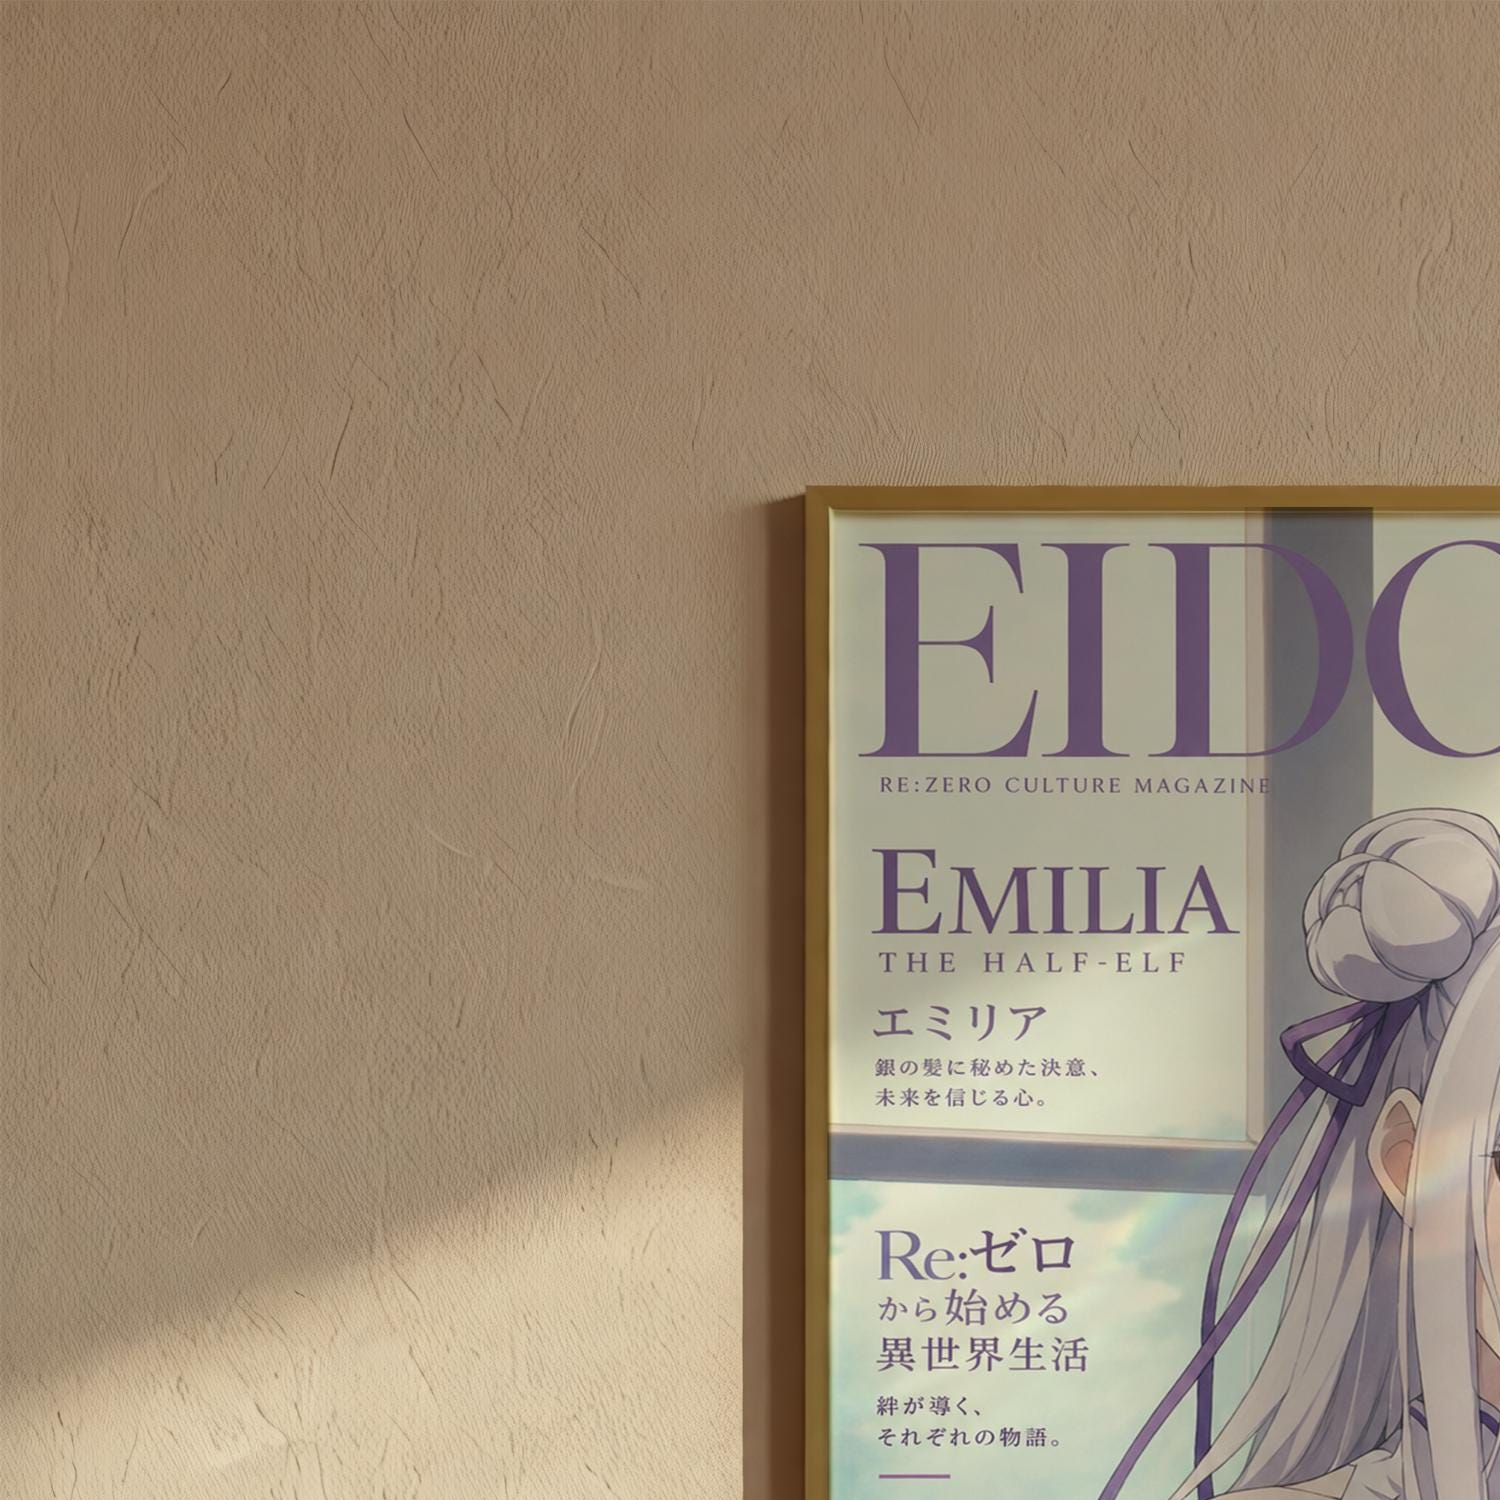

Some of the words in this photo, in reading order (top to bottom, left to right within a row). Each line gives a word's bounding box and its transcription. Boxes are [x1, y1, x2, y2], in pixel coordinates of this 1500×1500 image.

[879, 776, 992, 795] RE:ZERO
[1004, 776, 1121, 795] CULTURE
[1133, 776, 1270, 795] MAGAZINE
[878, 951, 957, 974] THE
[983, 951, 1186, 974] HALF-ELF
[871, 1003, 1047, 1042] エミリア
[874, 1057, 1100, 1078] 銀の髪に秘めた決意、
[874, 1086, 1047, 1108] 未来を信じる心。
[874, 1227, 1075, 1281] Re:ゼロ
[876, 1287, 1069, 1327] から始める
[875, 1336, 1090, 1373] 異世界生活
[876, 1395, 982, 1417] 絆が導く、
[876, 1427, 1061, 1448] それぞれの物語。
